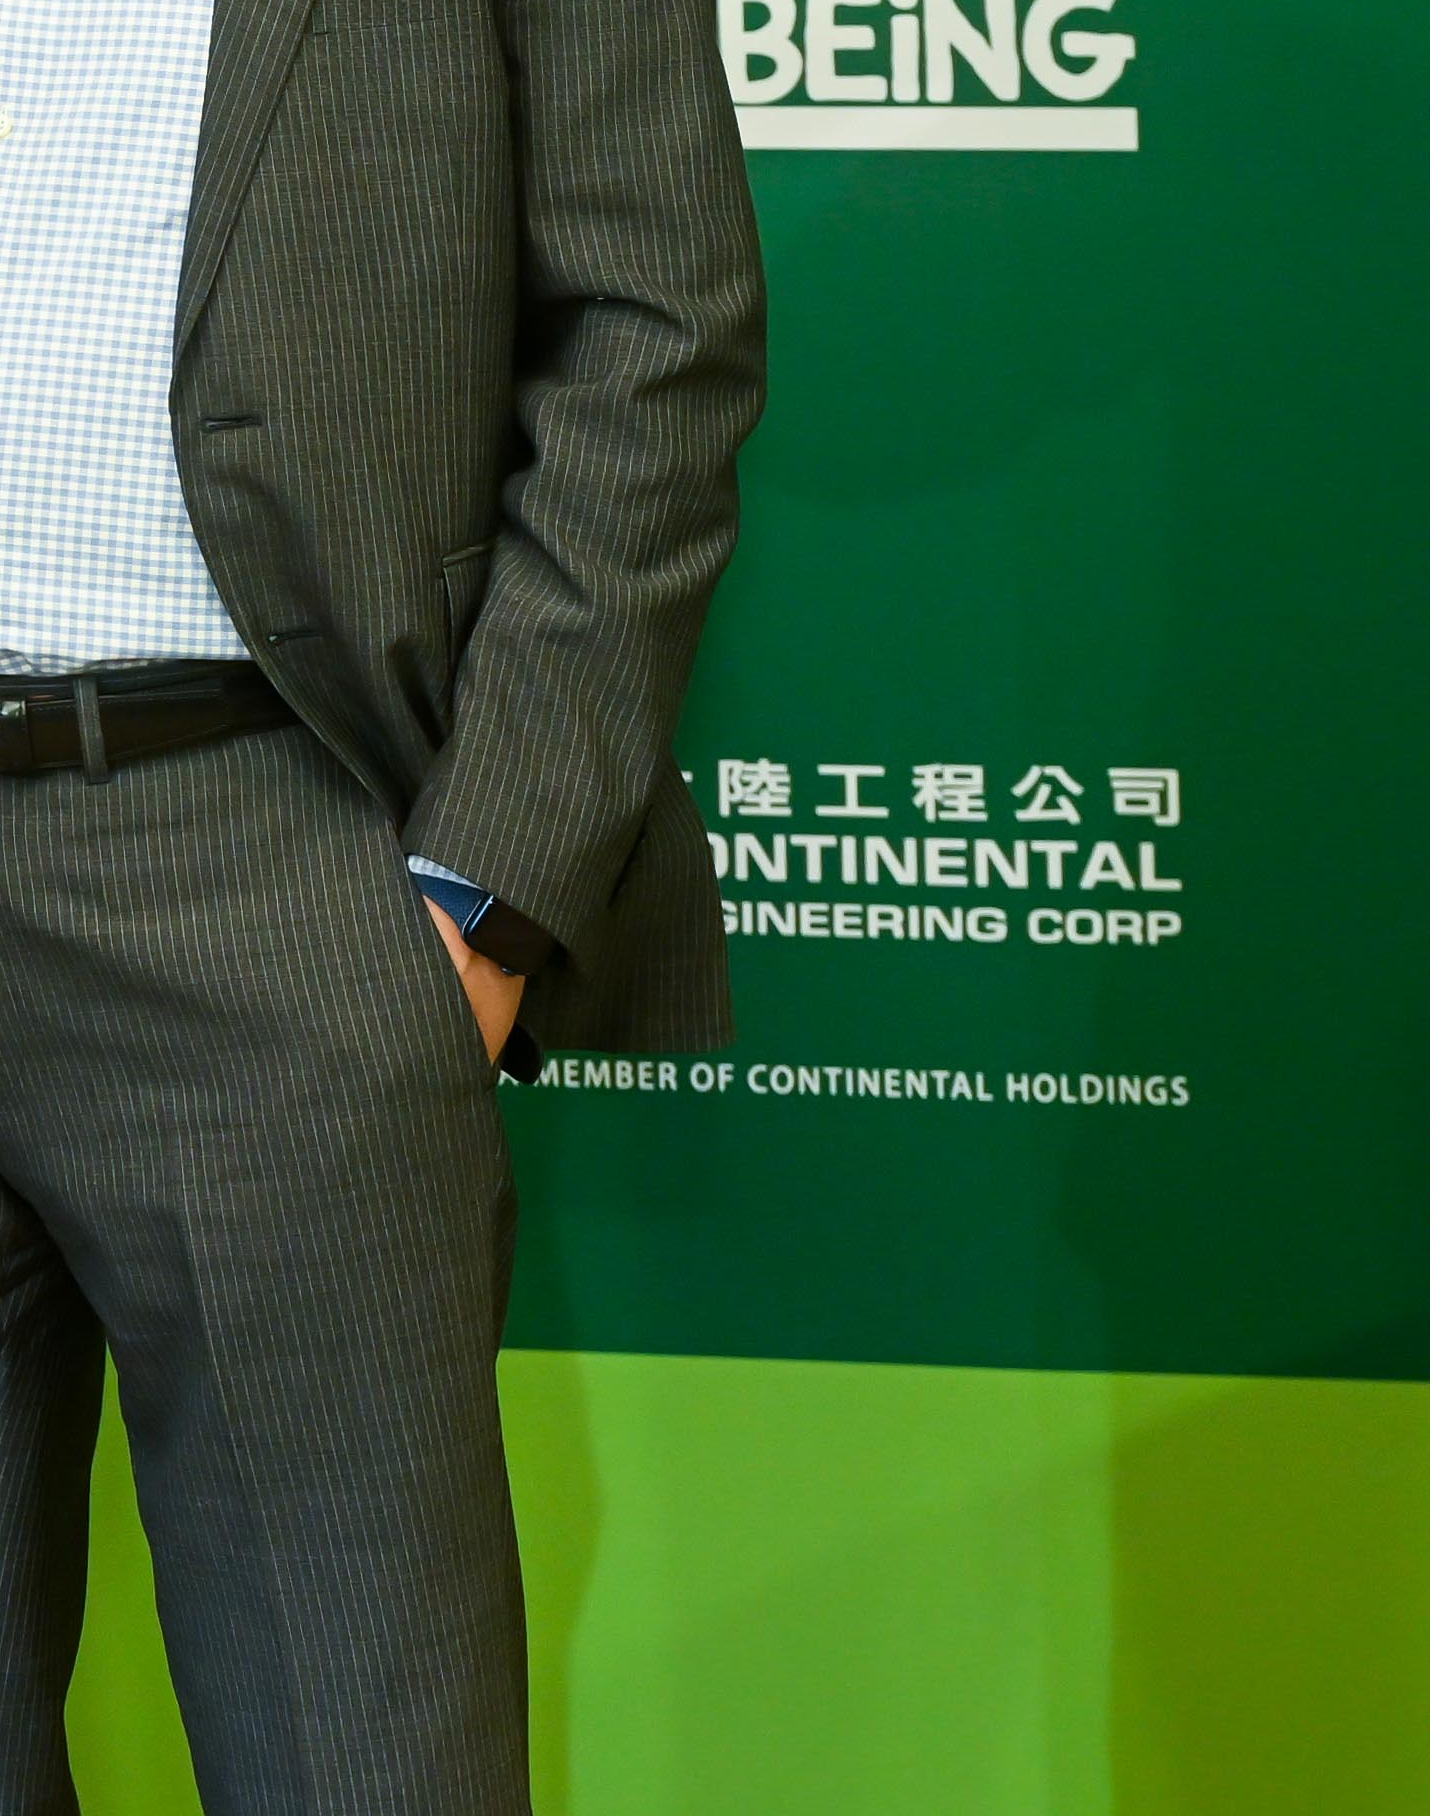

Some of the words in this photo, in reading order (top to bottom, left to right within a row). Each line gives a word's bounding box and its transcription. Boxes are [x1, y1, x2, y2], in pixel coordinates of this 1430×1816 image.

[681, 758, 1180, 826] 陸工程公司
[1027, 908, 1182, 945] CORP
[689, 1062, 734, 1092] OF
[747, 1064, 993, 1102] CONTINENTAL
[1006, 1072, 1189, 1106] HOLDINGS
